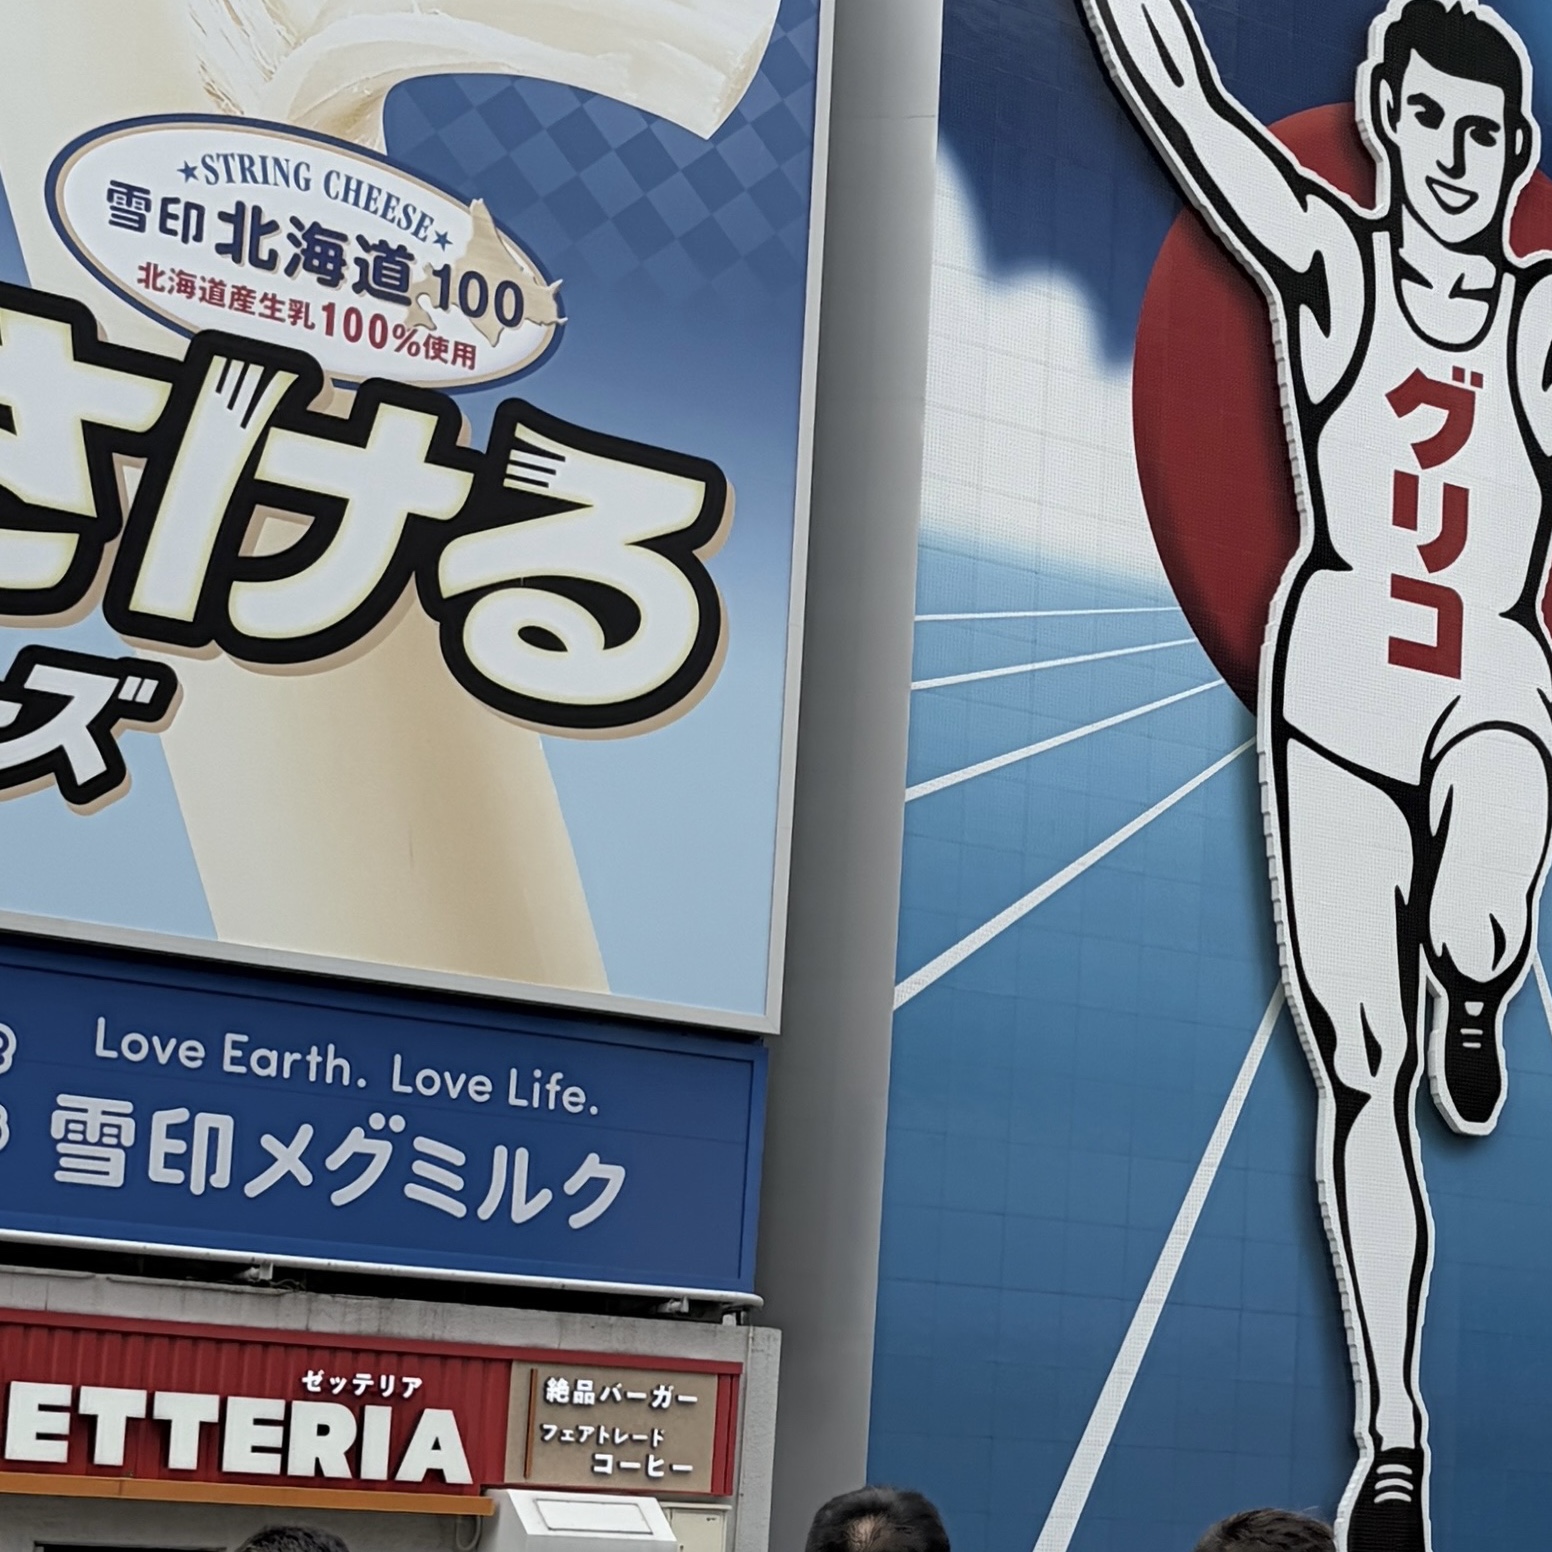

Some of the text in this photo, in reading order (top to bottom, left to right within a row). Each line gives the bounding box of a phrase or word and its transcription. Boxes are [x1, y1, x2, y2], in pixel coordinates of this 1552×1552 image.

[200, 151, 434, 242] STRING CHEESE
[136, 260, 478, 371] 北海道産生乳100%使用
[1385, 365, 1484, 680] グリコ
[95, 1017, 599, 1115] Love Earth. Love Life.
[50, 1094, 625, 1229] 雪印メグミルク
[302, 1370, 423, 1400] ゼッテリア
[546, 1377, 698, 1408] 絶品バーガー
[5, 1381, 473, 1485] ETTERIA
[542, 1424, 665, 1447] フェアトレード
[593, 1453, 693, 1477] コーヒー
